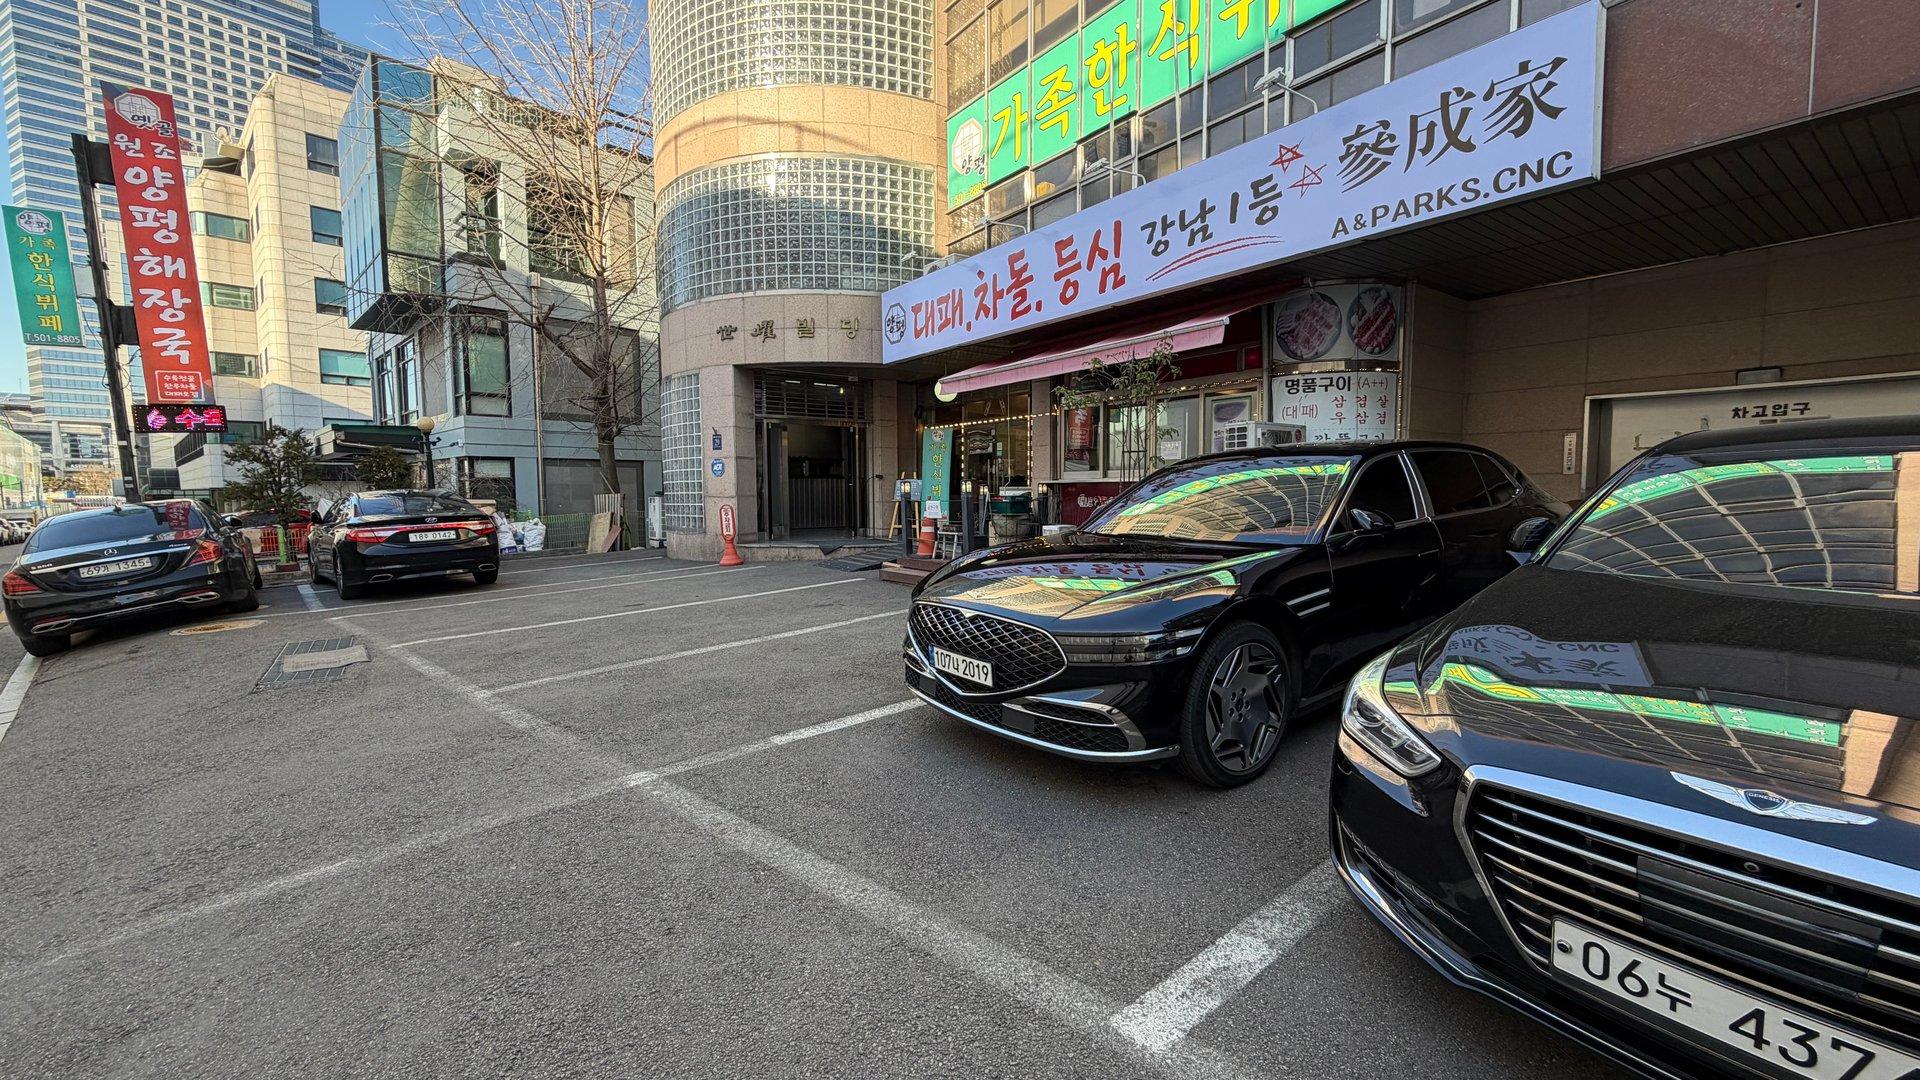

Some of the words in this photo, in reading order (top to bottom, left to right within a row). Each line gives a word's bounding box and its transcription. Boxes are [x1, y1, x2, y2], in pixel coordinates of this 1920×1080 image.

[113, 132, 177, 160] 원조
[1140, 197, 1217, 258] 강남
[19, 235, 56, 250] 가족
[124, 165, 192, 365] 양평해장국
[28, 251, 63, 332] 한식뷔페
[25, 333, 80, 344] T.501-8805
[1285, 375, 1351, 395] 명품구이
[1357, 376, 1389, 390] (A++)
[1330, 411, 1388, 425] 우삼겹
[1732, 402, 1811, 419] 차고입구
[115, 558, 146, 571] 1345
[962, 659, 989, 683] 2019
[1748, 792, 1781, 803] GENESIS
[1582, 940, 1692, 1012] 06누
[1728, 1007, 1920, 1080] 437
